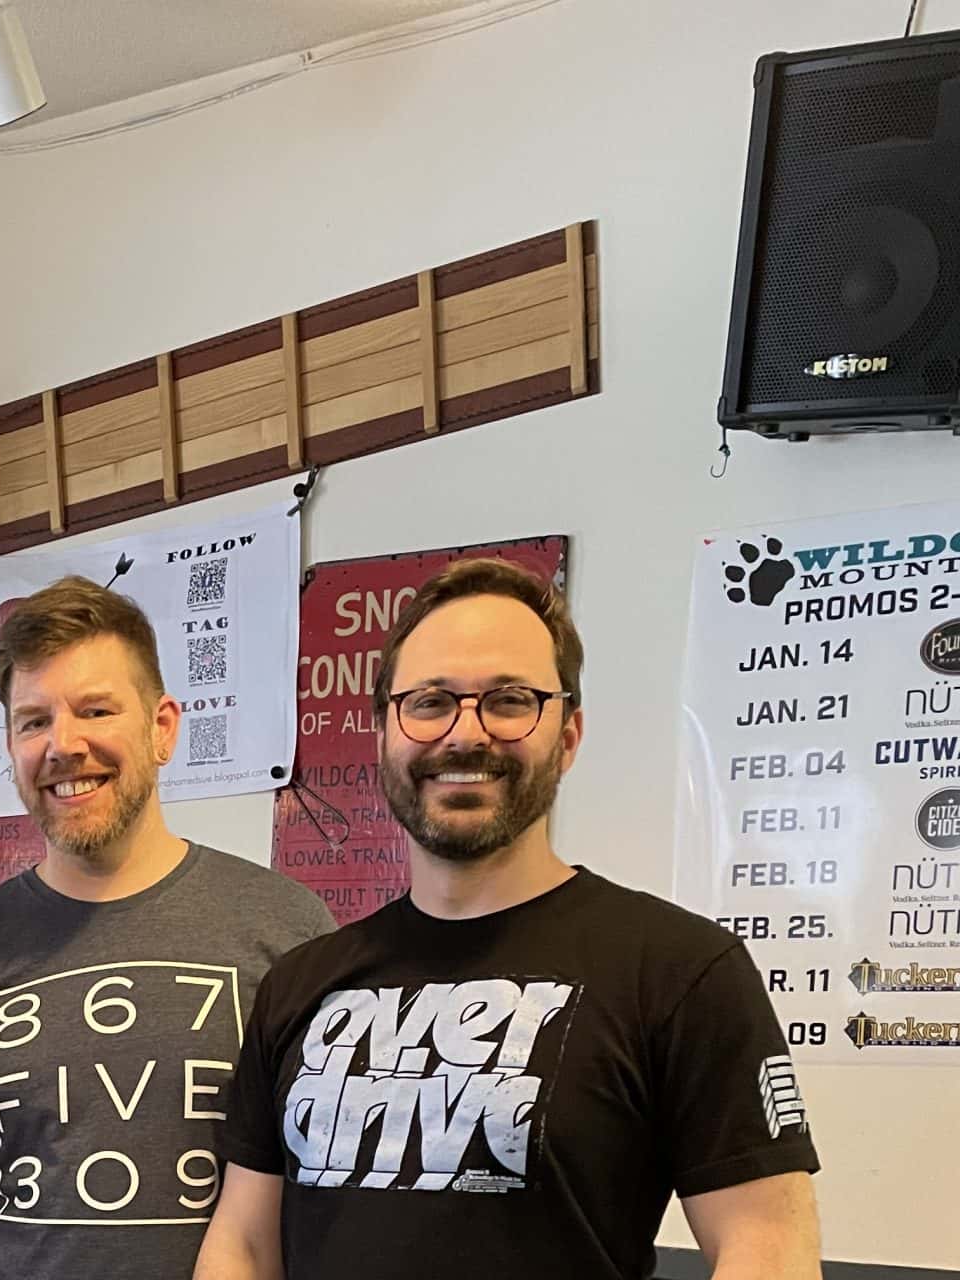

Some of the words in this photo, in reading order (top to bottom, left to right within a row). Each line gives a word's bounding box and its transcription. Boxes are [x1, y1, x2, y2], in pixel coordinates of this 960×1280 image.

[813, 356, 888, 377] KUSTOM
[166, 532, 257, 564] FOLLOW
[784, 588, 918, 625] PROMOS
[182, 616, 229, 634] TAG
[739, 643, 809, 673] JAN.
[820, 638, 854, 665] 14
[181, 695, 237, 713] LOVE
[736, 698, 806, 727] JAN.
[817, 694, 848, 721] 21
[301, 712, 331, 735] OF
[875, 736, 960, 765] CUTW
[730, 754, 793, 781] FEB.
[805, 750, 846, 777] 04
[741, 808, 806, 834] FEB.
[817, 806, 840, 830] 11
[285, 849, 347, 868] LOWER
[352, 847, 404, 865] TRAIL
[731, 863, 794, 887] FEB.
[806, 860, 838, 885] 18
[787, 915, 833, 939] 25.
[806, 969, 829, 992] 11
[788, 1022, 827, 1046] 09
